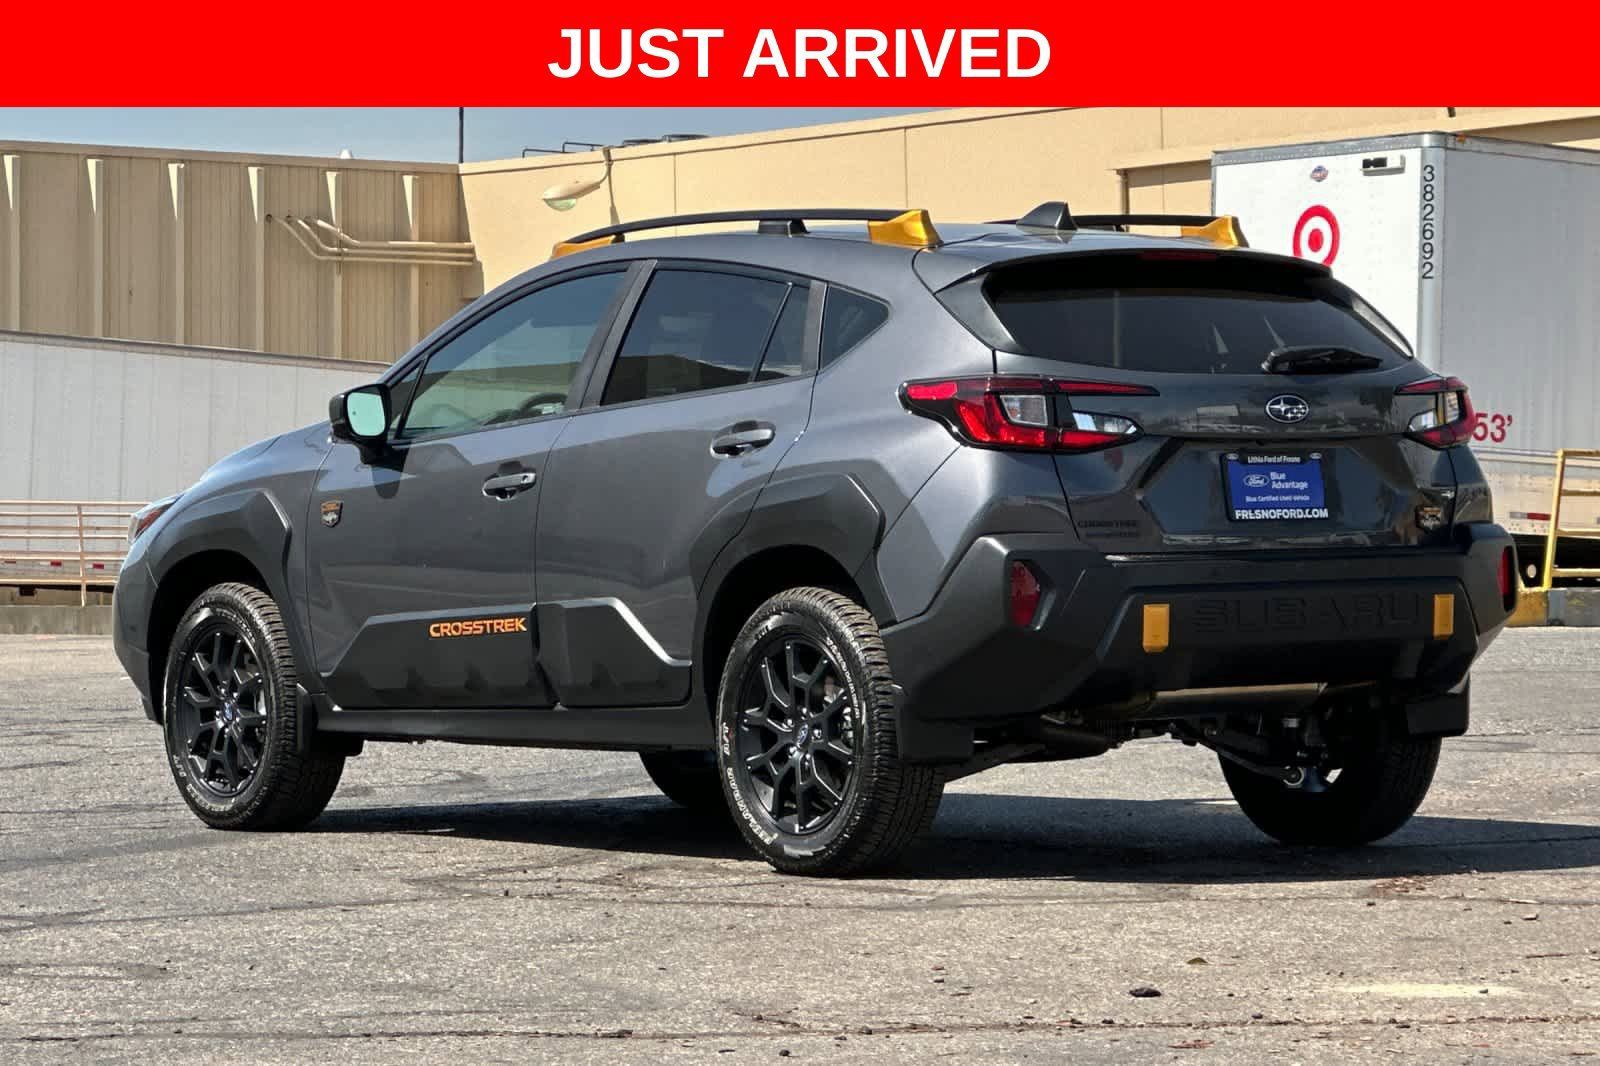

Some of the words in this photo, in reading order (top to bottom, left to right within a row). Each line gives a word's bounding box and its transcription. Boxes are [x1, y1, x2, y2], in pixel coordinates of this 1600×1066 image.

[1422, 164, 1435, 280] 382692
[1264, 455, 1277, 463] Ford
[1270, 472, 1286, 480] Blue
[1272, 481, 1308, 490] Advantage
[1235, 508, 1328, 519] FRESNOFORD.COM
[1193, 592, 1422, 634] SUBARU
[429, 617, 527, 638] CROSSTREK
